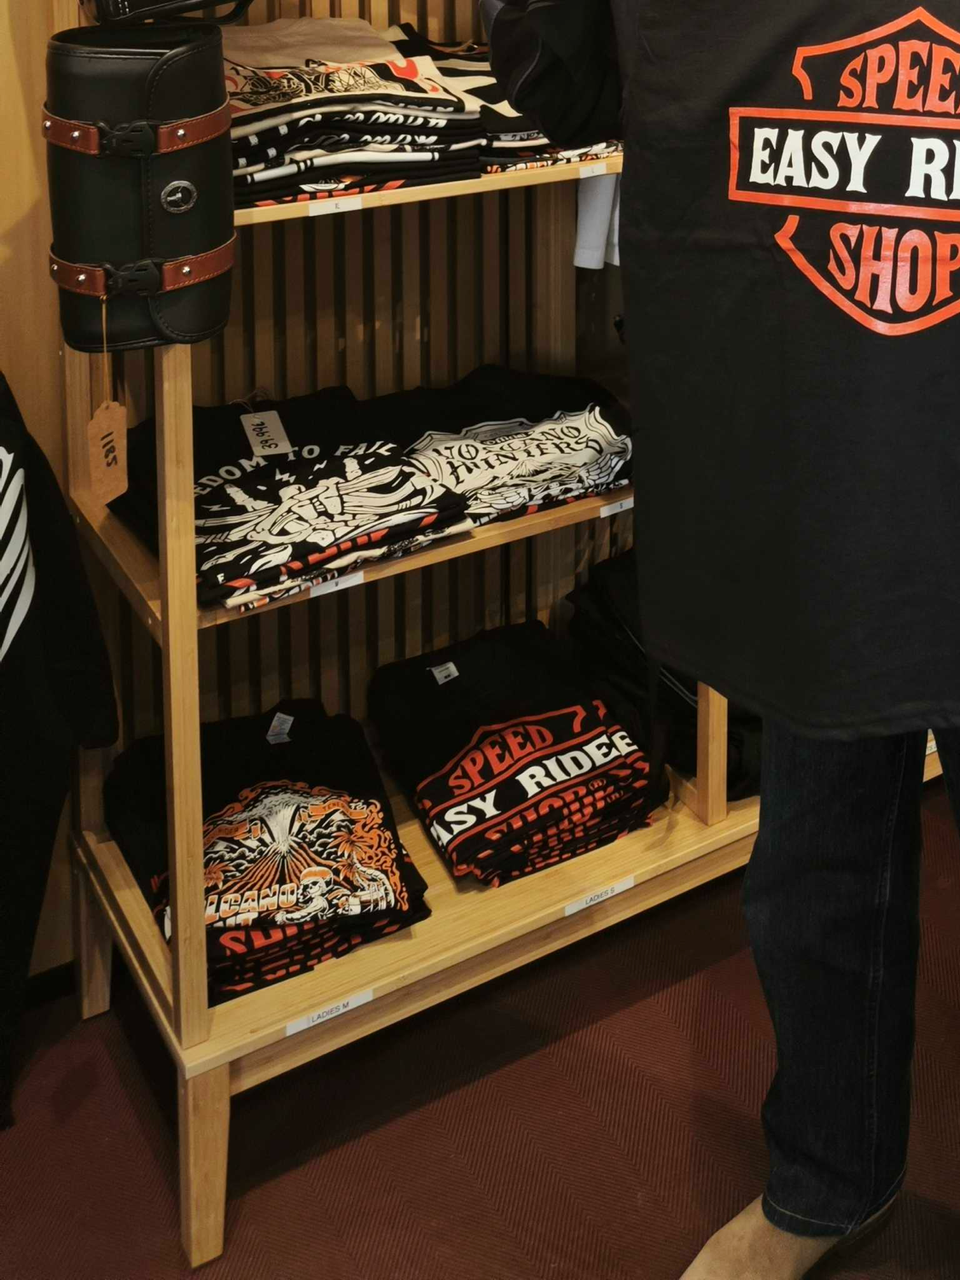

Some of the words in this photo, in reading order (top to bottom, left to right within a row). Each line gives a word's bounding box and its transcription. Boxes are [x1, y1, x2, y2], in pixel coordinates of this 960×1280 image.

[748, 127, 882, 193] EASY
[251, 420, 279, 451] 39.99€
[287, 444, 320, 461] TO
[432, 425, 582, 462] VOLCANO
[446, 434, 604, 486] HUNTERS
[448, 724, 555, 796] SPEED
[585, 891, 609, 905] LADIES
[609, 887, 616, 895] S
[311, 1004, 341, 1022] LADIES
[342, 1001, 350, 1010] M
